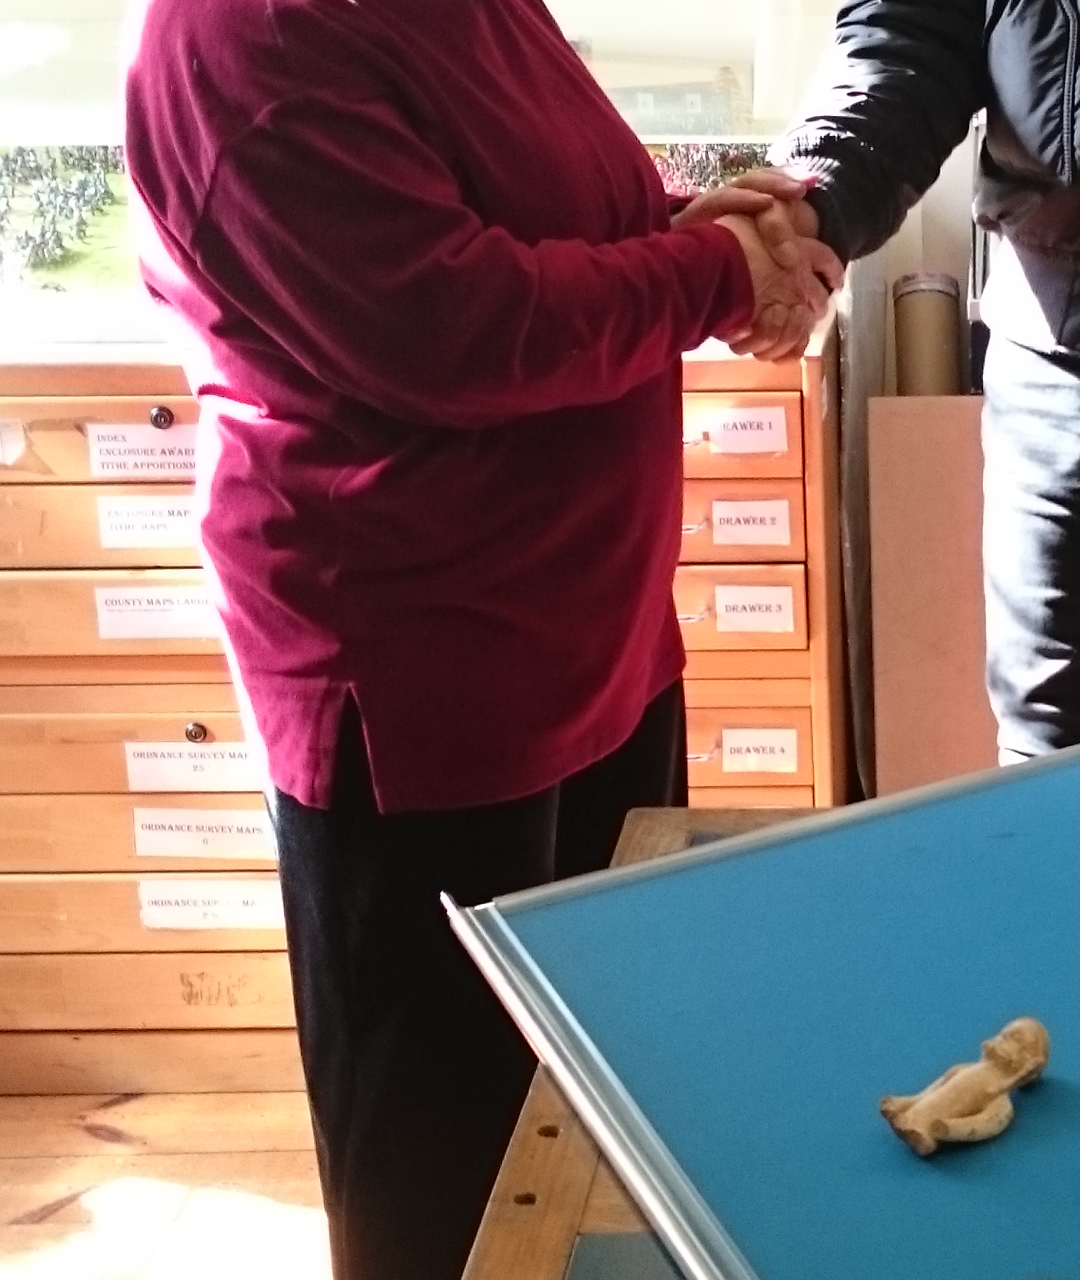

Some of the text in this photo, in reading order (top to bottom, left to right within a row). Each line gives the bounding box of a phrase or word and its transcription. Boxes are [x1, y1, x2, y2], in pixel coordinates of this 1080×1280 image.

[721, 421, 764, 431] RAWER
[97, 434, 127, 442] INDEX
[99, 447, 156, 456] ENCLOSURE
[101, 461, 129, 470] TITHE
[719, 516, 767, 525] DRAWER
[105, 597, 143, 606] COUNTY
[146, 598, 174, 606] MAPS
[724, 603, 773, 613] DRAWER
[133, 751, 184, 759] ORDNANCE
[187, 751, 226, 759] SURVEY
[729, 746, 775, 755] DRAWER
[141, 823, 264, 834] ORDNANCE SURVEY MAPS
[147, 899, 199, 907] ORDNANCE
